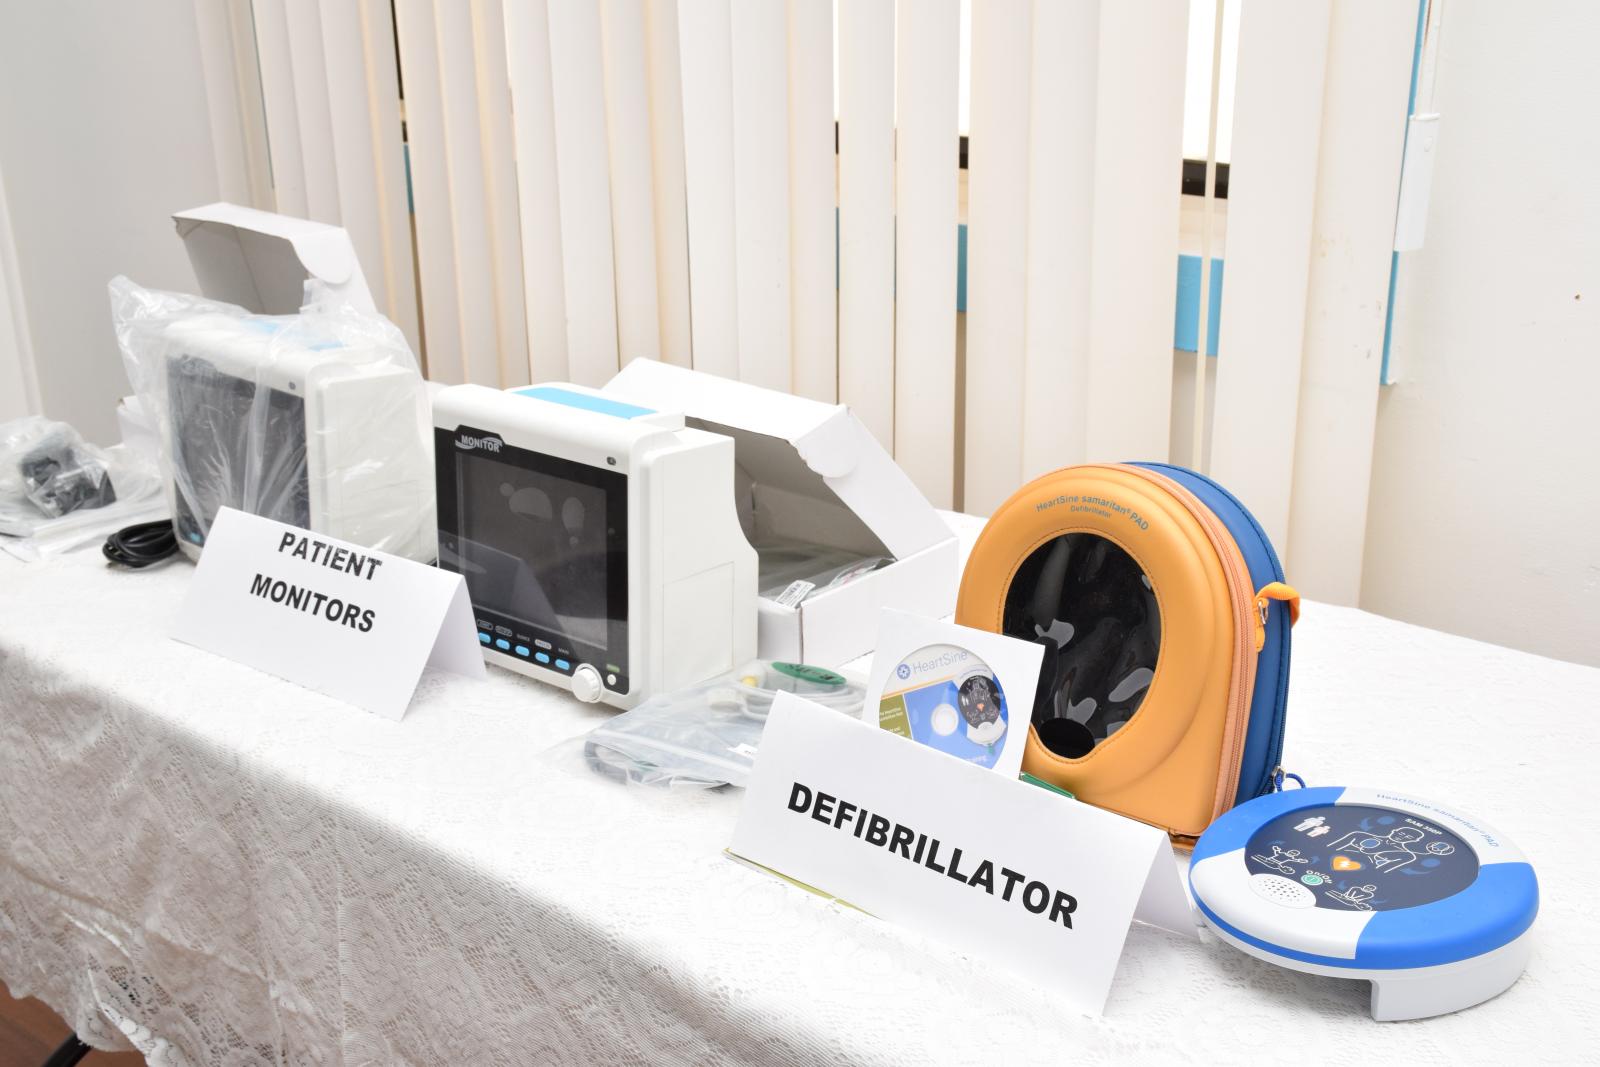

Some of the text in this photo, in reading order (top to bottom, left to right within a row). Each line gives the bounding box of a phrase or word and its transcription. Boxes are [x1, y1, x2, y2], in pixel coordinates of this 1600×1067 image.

[461, 434, 500, 453] MONITOR
[1036, 495, 1079, 513] HeartSine
[1130, 512, 1149, 531] PAD
[278, 531, 383, 581] PATIENT
[250, 573, 376, 633] MONITORS
[911, 651, 968, 674] HeartSine
[787, 781, 1078, 930] DEFIBRILLATOR
